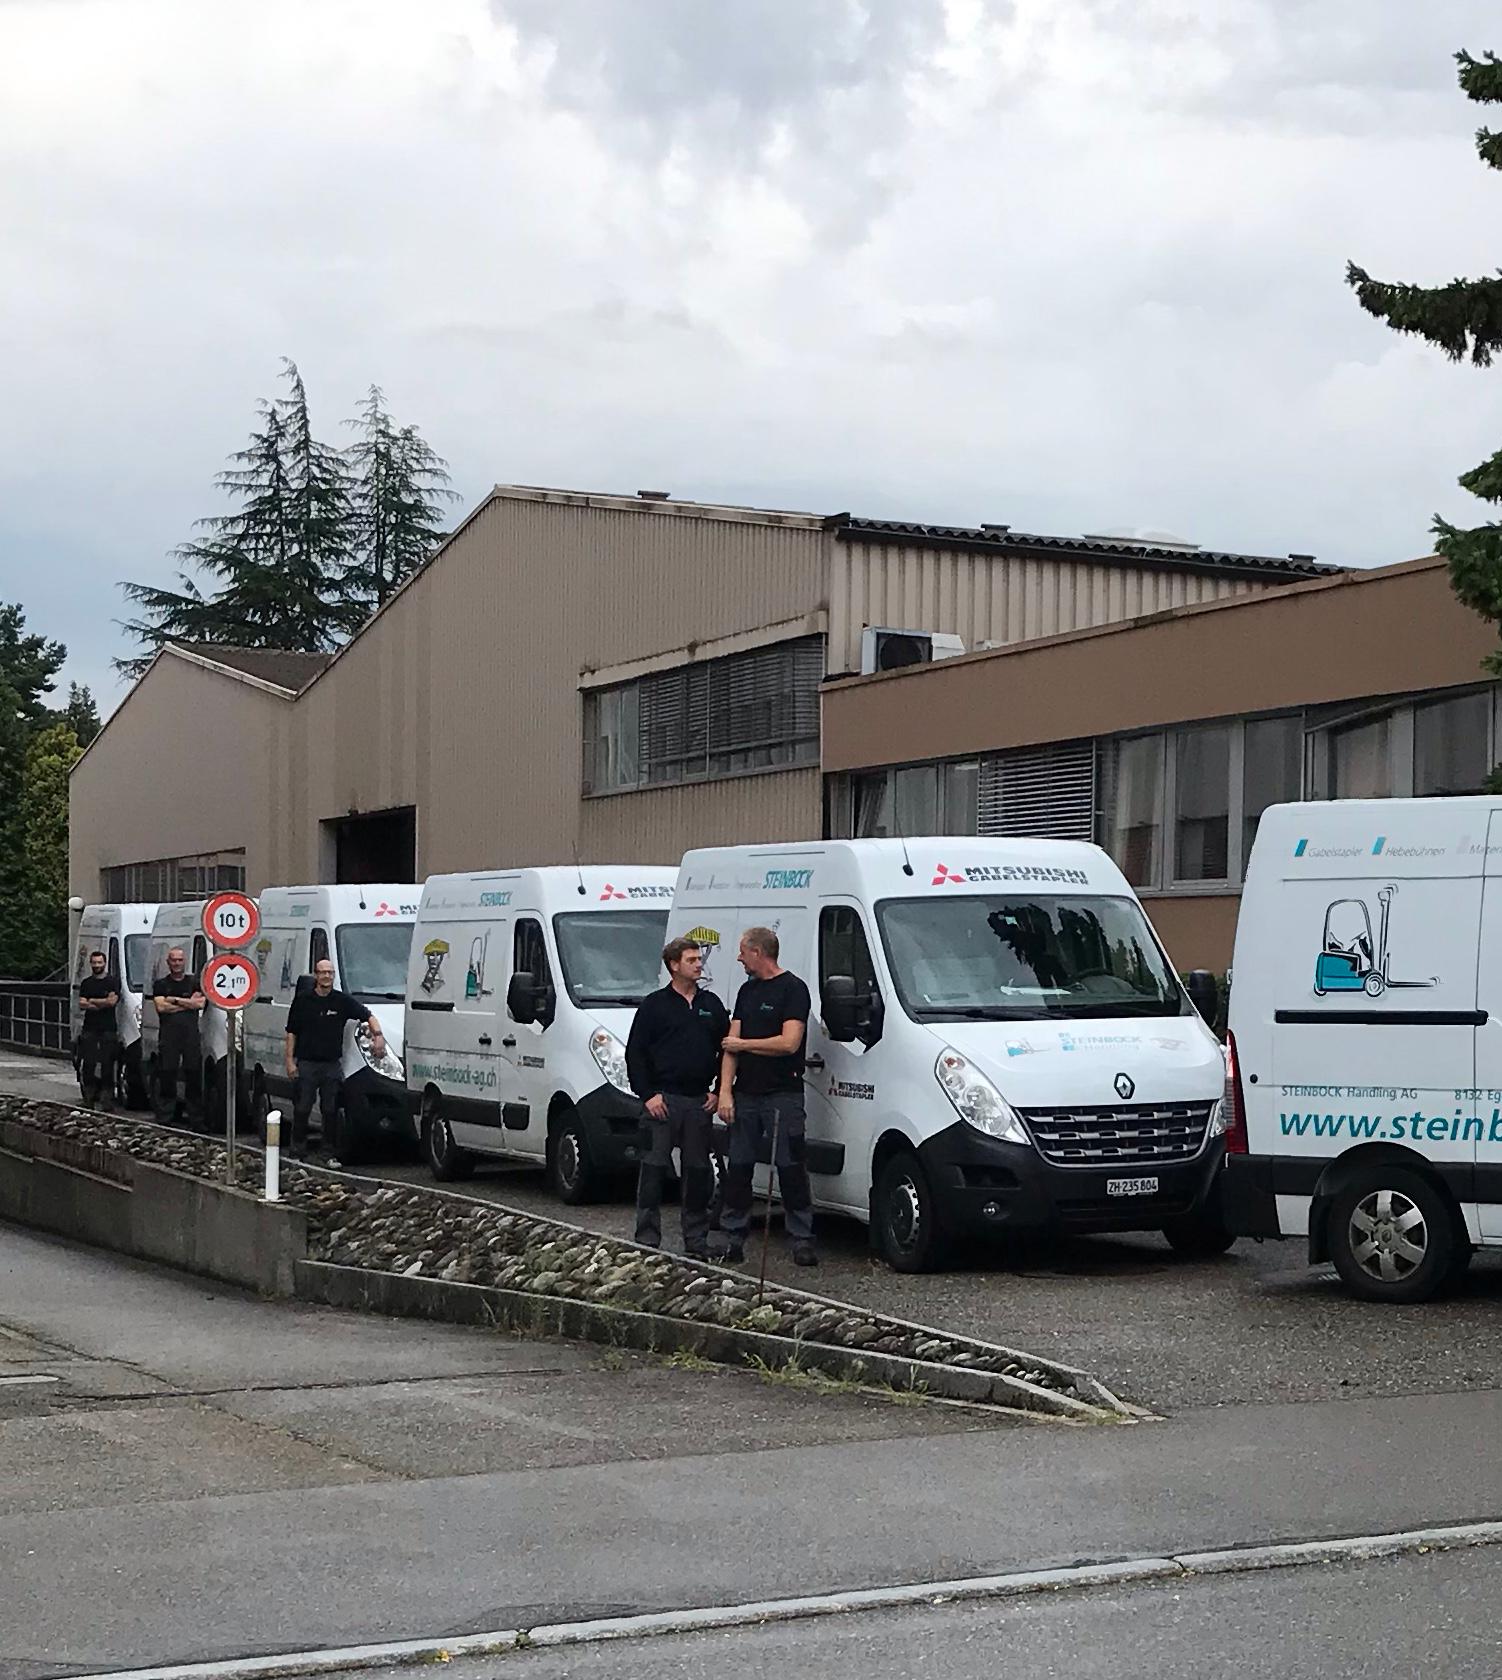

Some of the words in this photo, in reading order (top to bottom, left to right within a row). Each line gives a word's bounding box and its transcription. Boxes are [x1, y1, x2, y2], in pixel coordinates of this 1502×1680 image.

[762, 869, 815, 889] STEINBOCK
[964, 866, 1087, 879] MITSUBISHI
[219, 913, 236, 928] 10
[238, 914, 245, 928] t
[1281, 1085, 1343, 1098] STEINBOCK
[1346, 1086, 1398, 1101] Handling
[1400, 1087, 1419, 1100] AG
[1454, 1088, 1483, 1101] 8132
